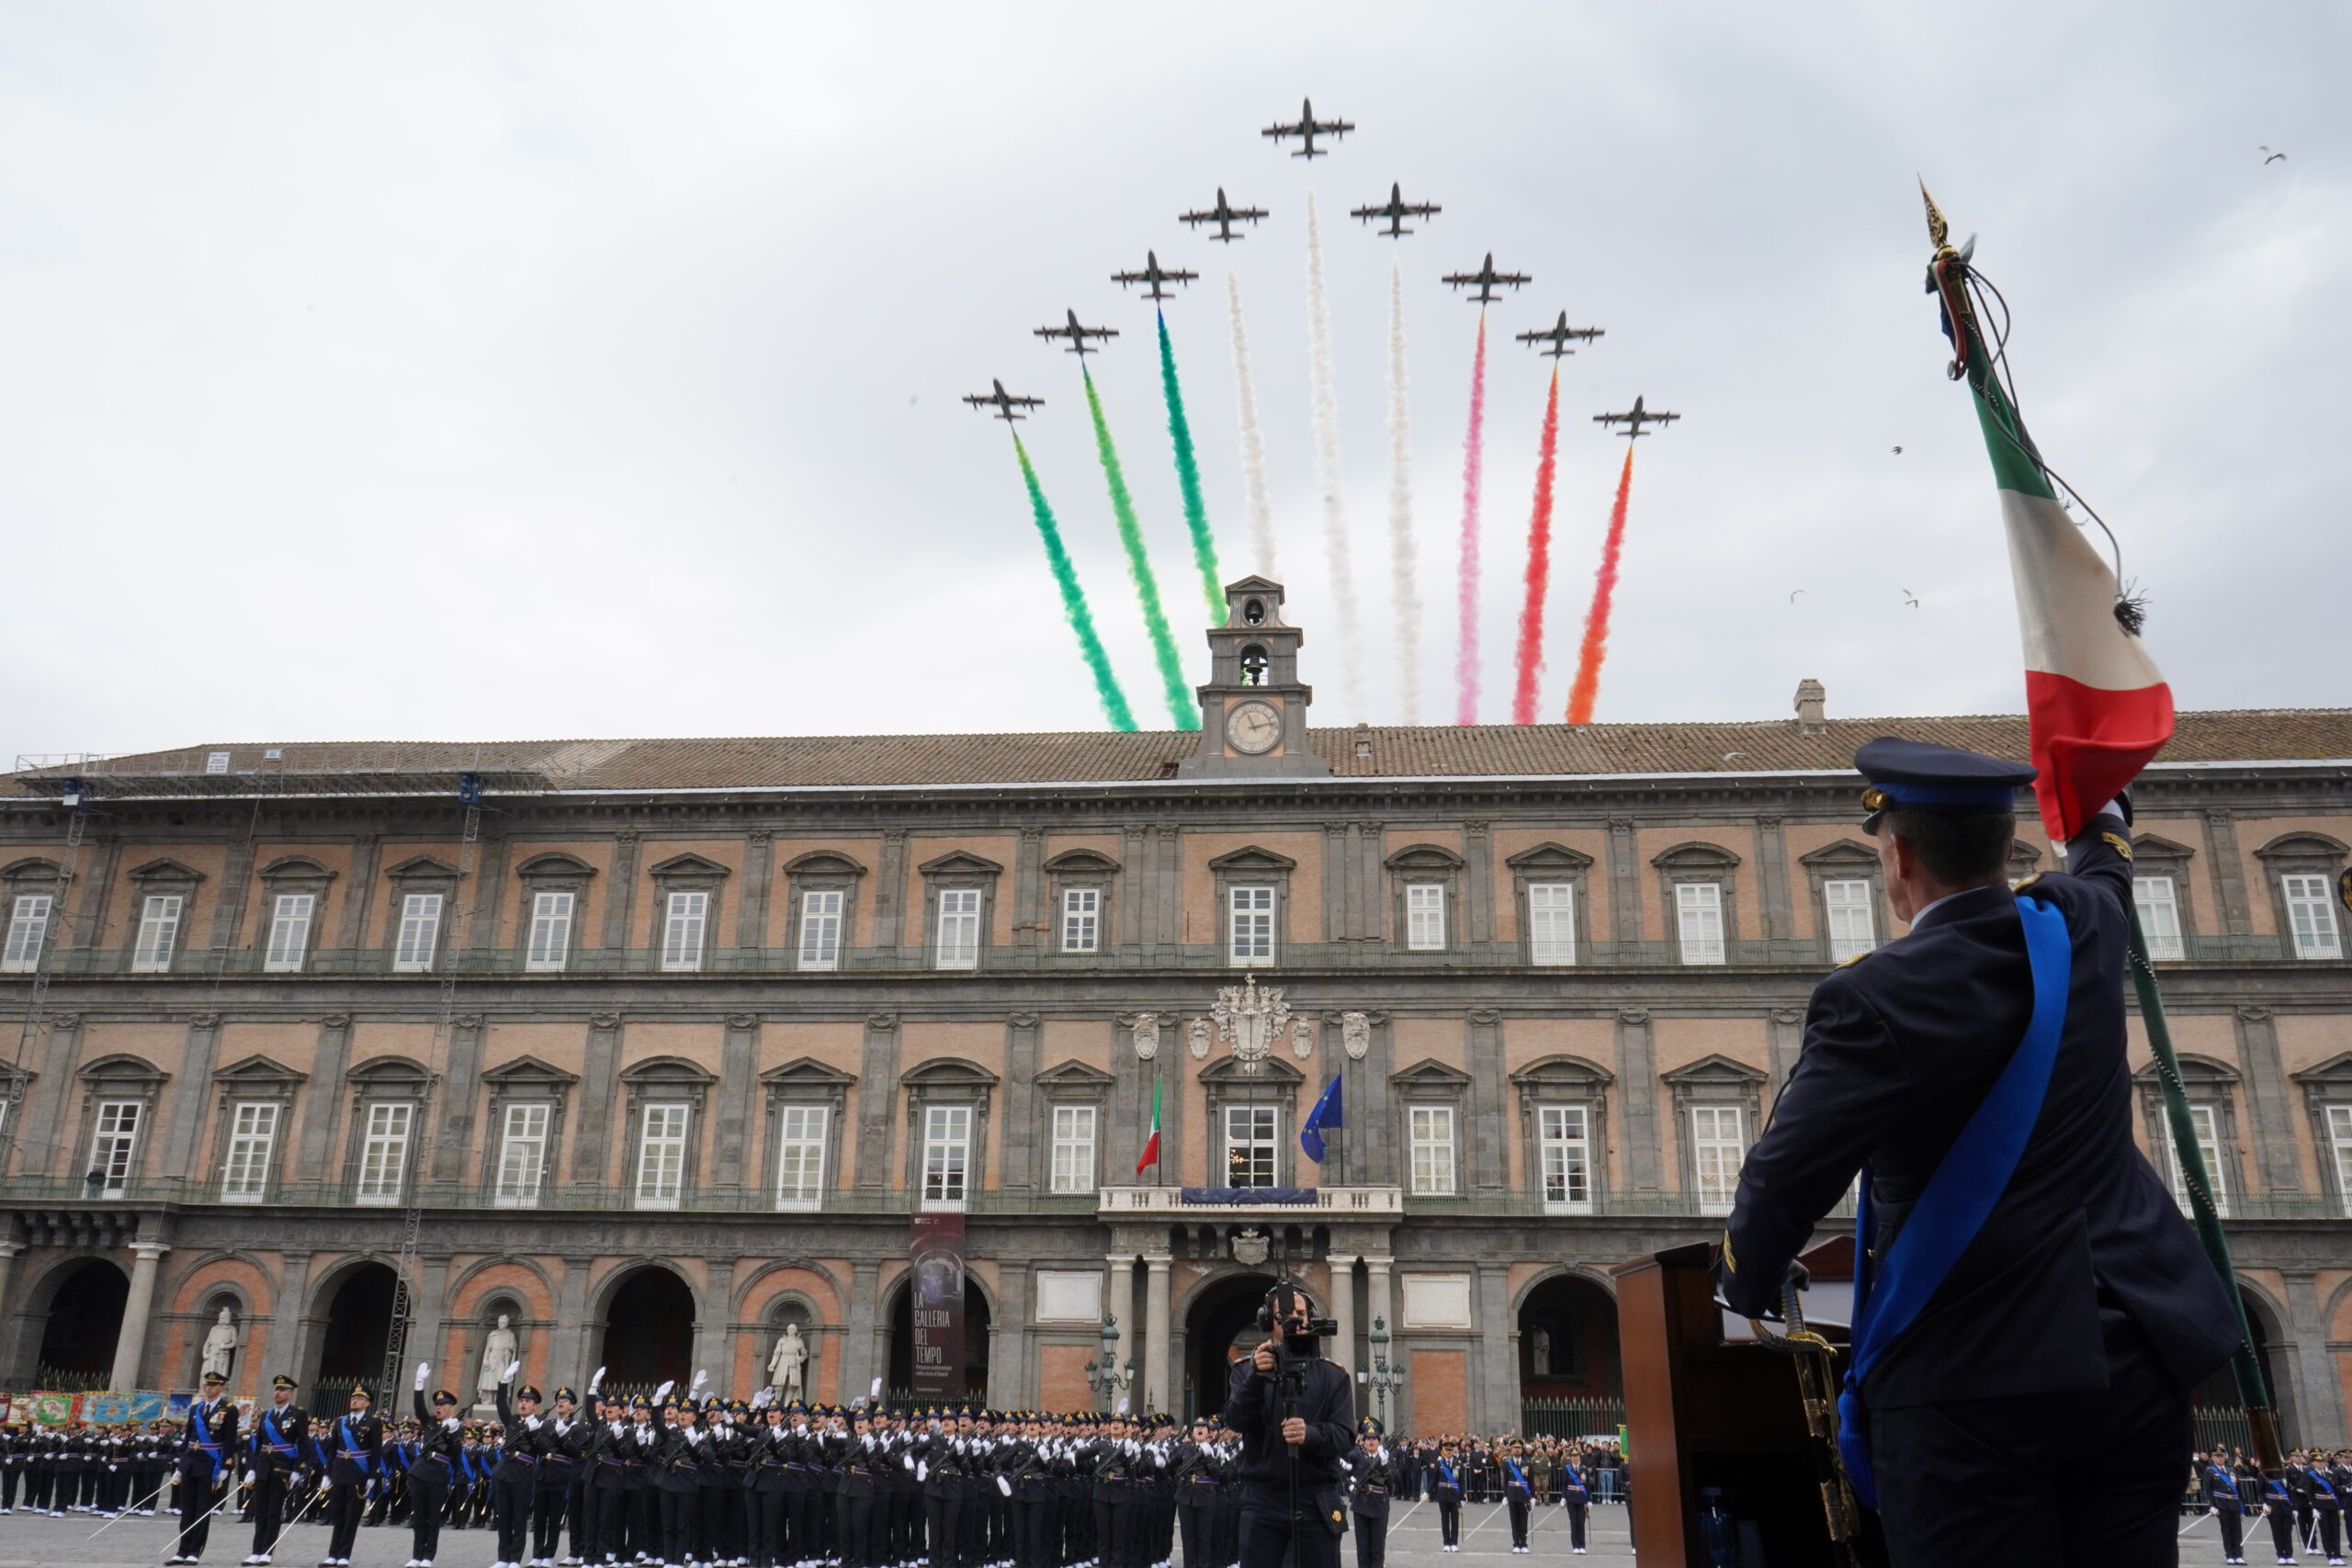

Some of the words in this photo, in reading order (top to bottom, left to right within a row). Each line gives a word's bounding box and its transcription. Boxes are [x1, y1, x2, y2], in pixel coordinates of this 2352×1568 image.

[914, 1292, 923, 1309] LA
[915, 1328, 929, 1346] DEL
[915, 1346, 942, 1364] TEMPO
